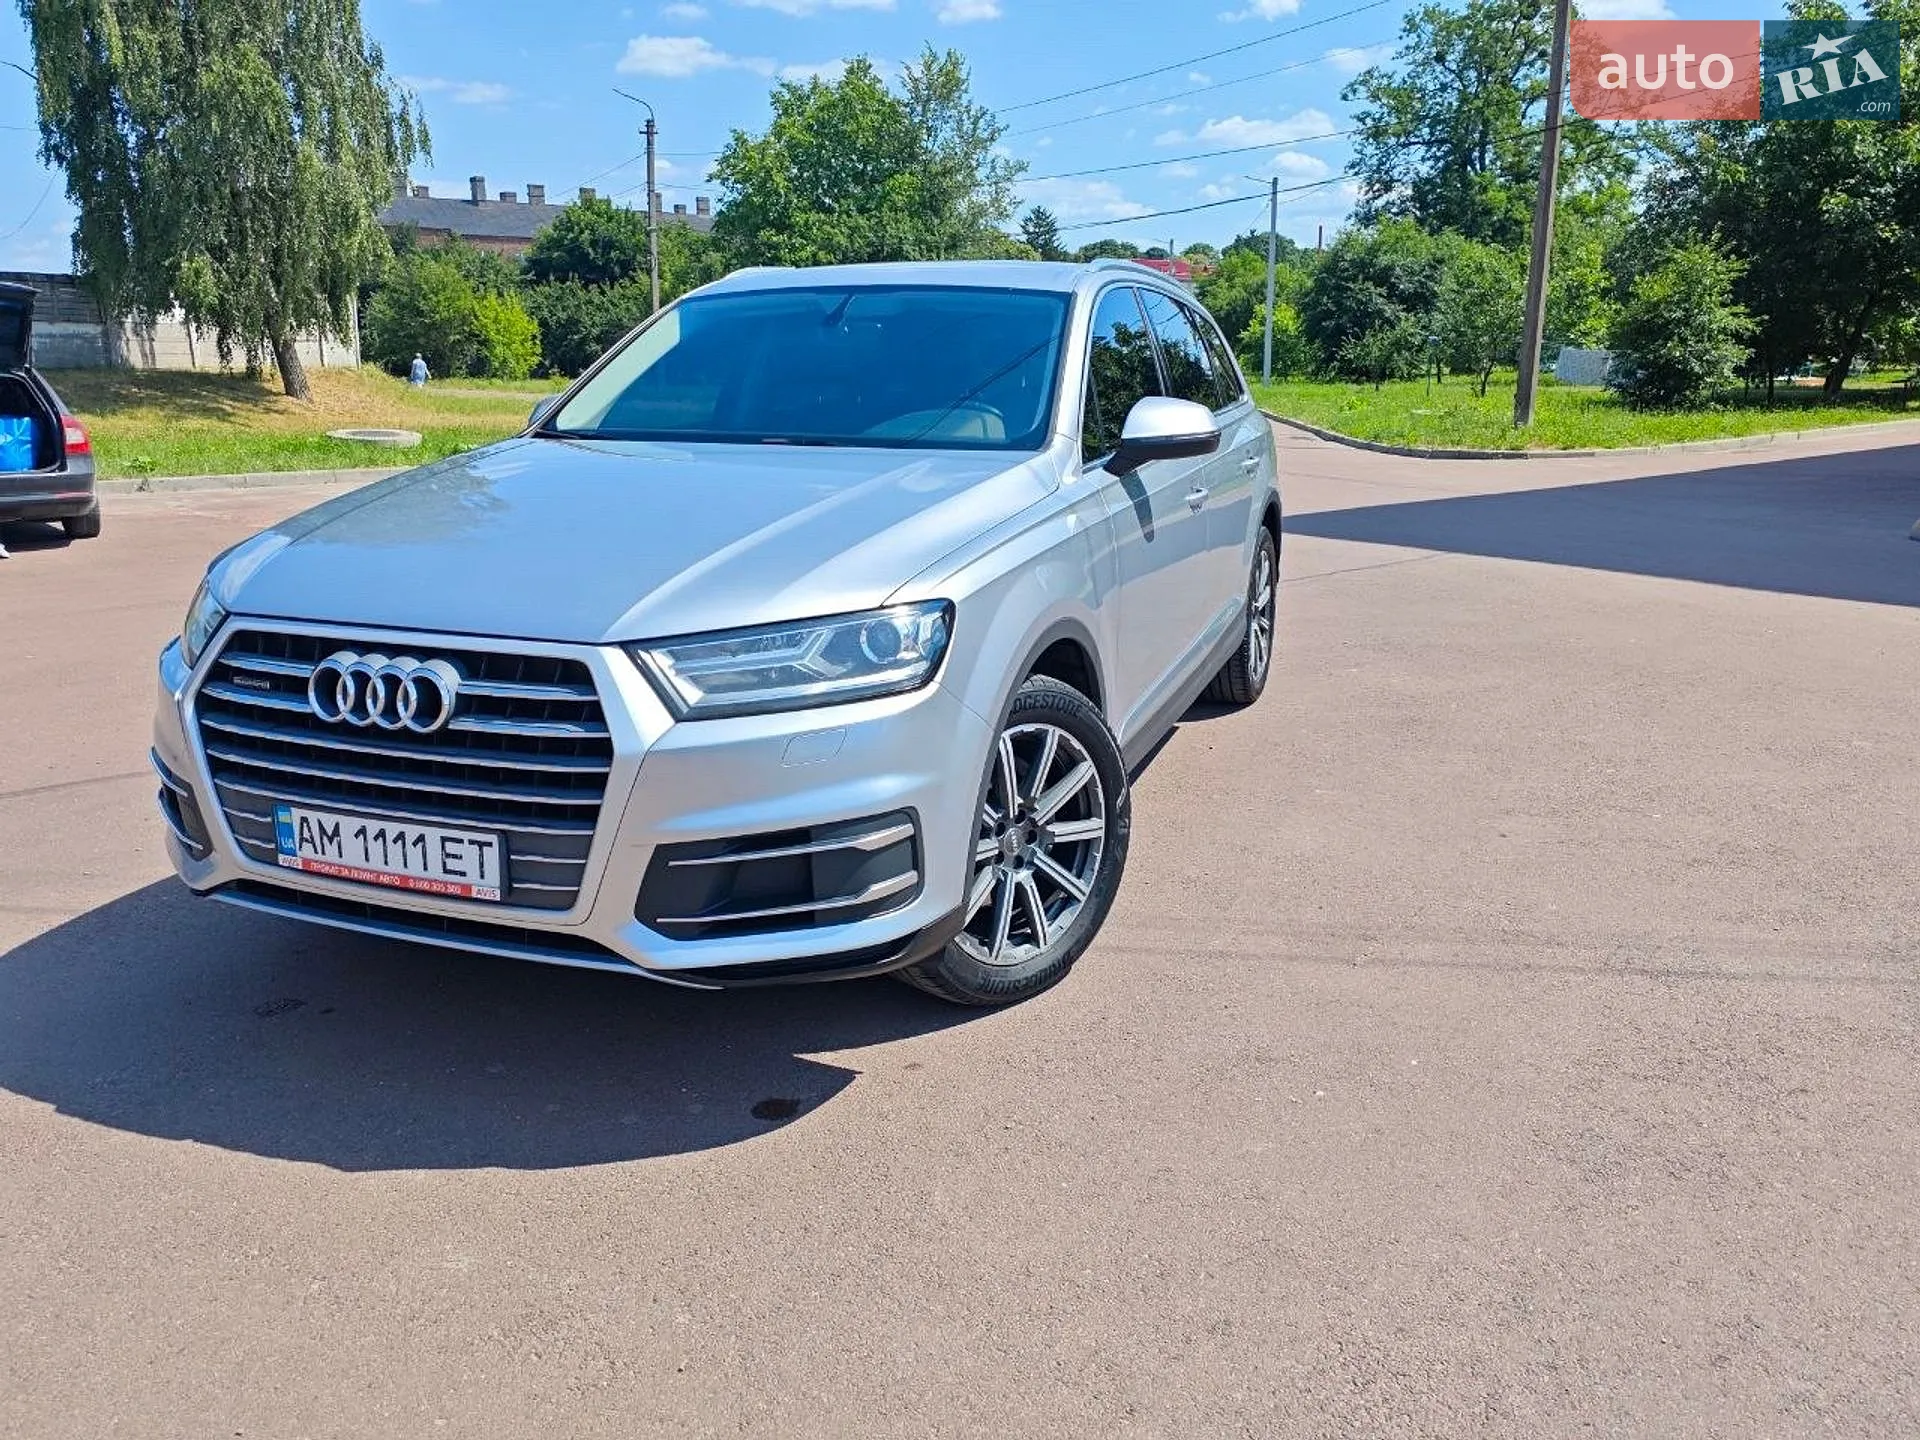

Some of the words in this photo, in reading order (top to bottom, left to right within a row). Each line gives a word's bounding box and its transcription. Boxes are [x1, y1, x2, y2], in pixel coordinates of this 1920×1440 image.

[280, 836, 296, 851] UA
[299, 816, 343, 858] AM
[353, 825, 429, 871] 1111
[440, 836, 494, 880] ET
